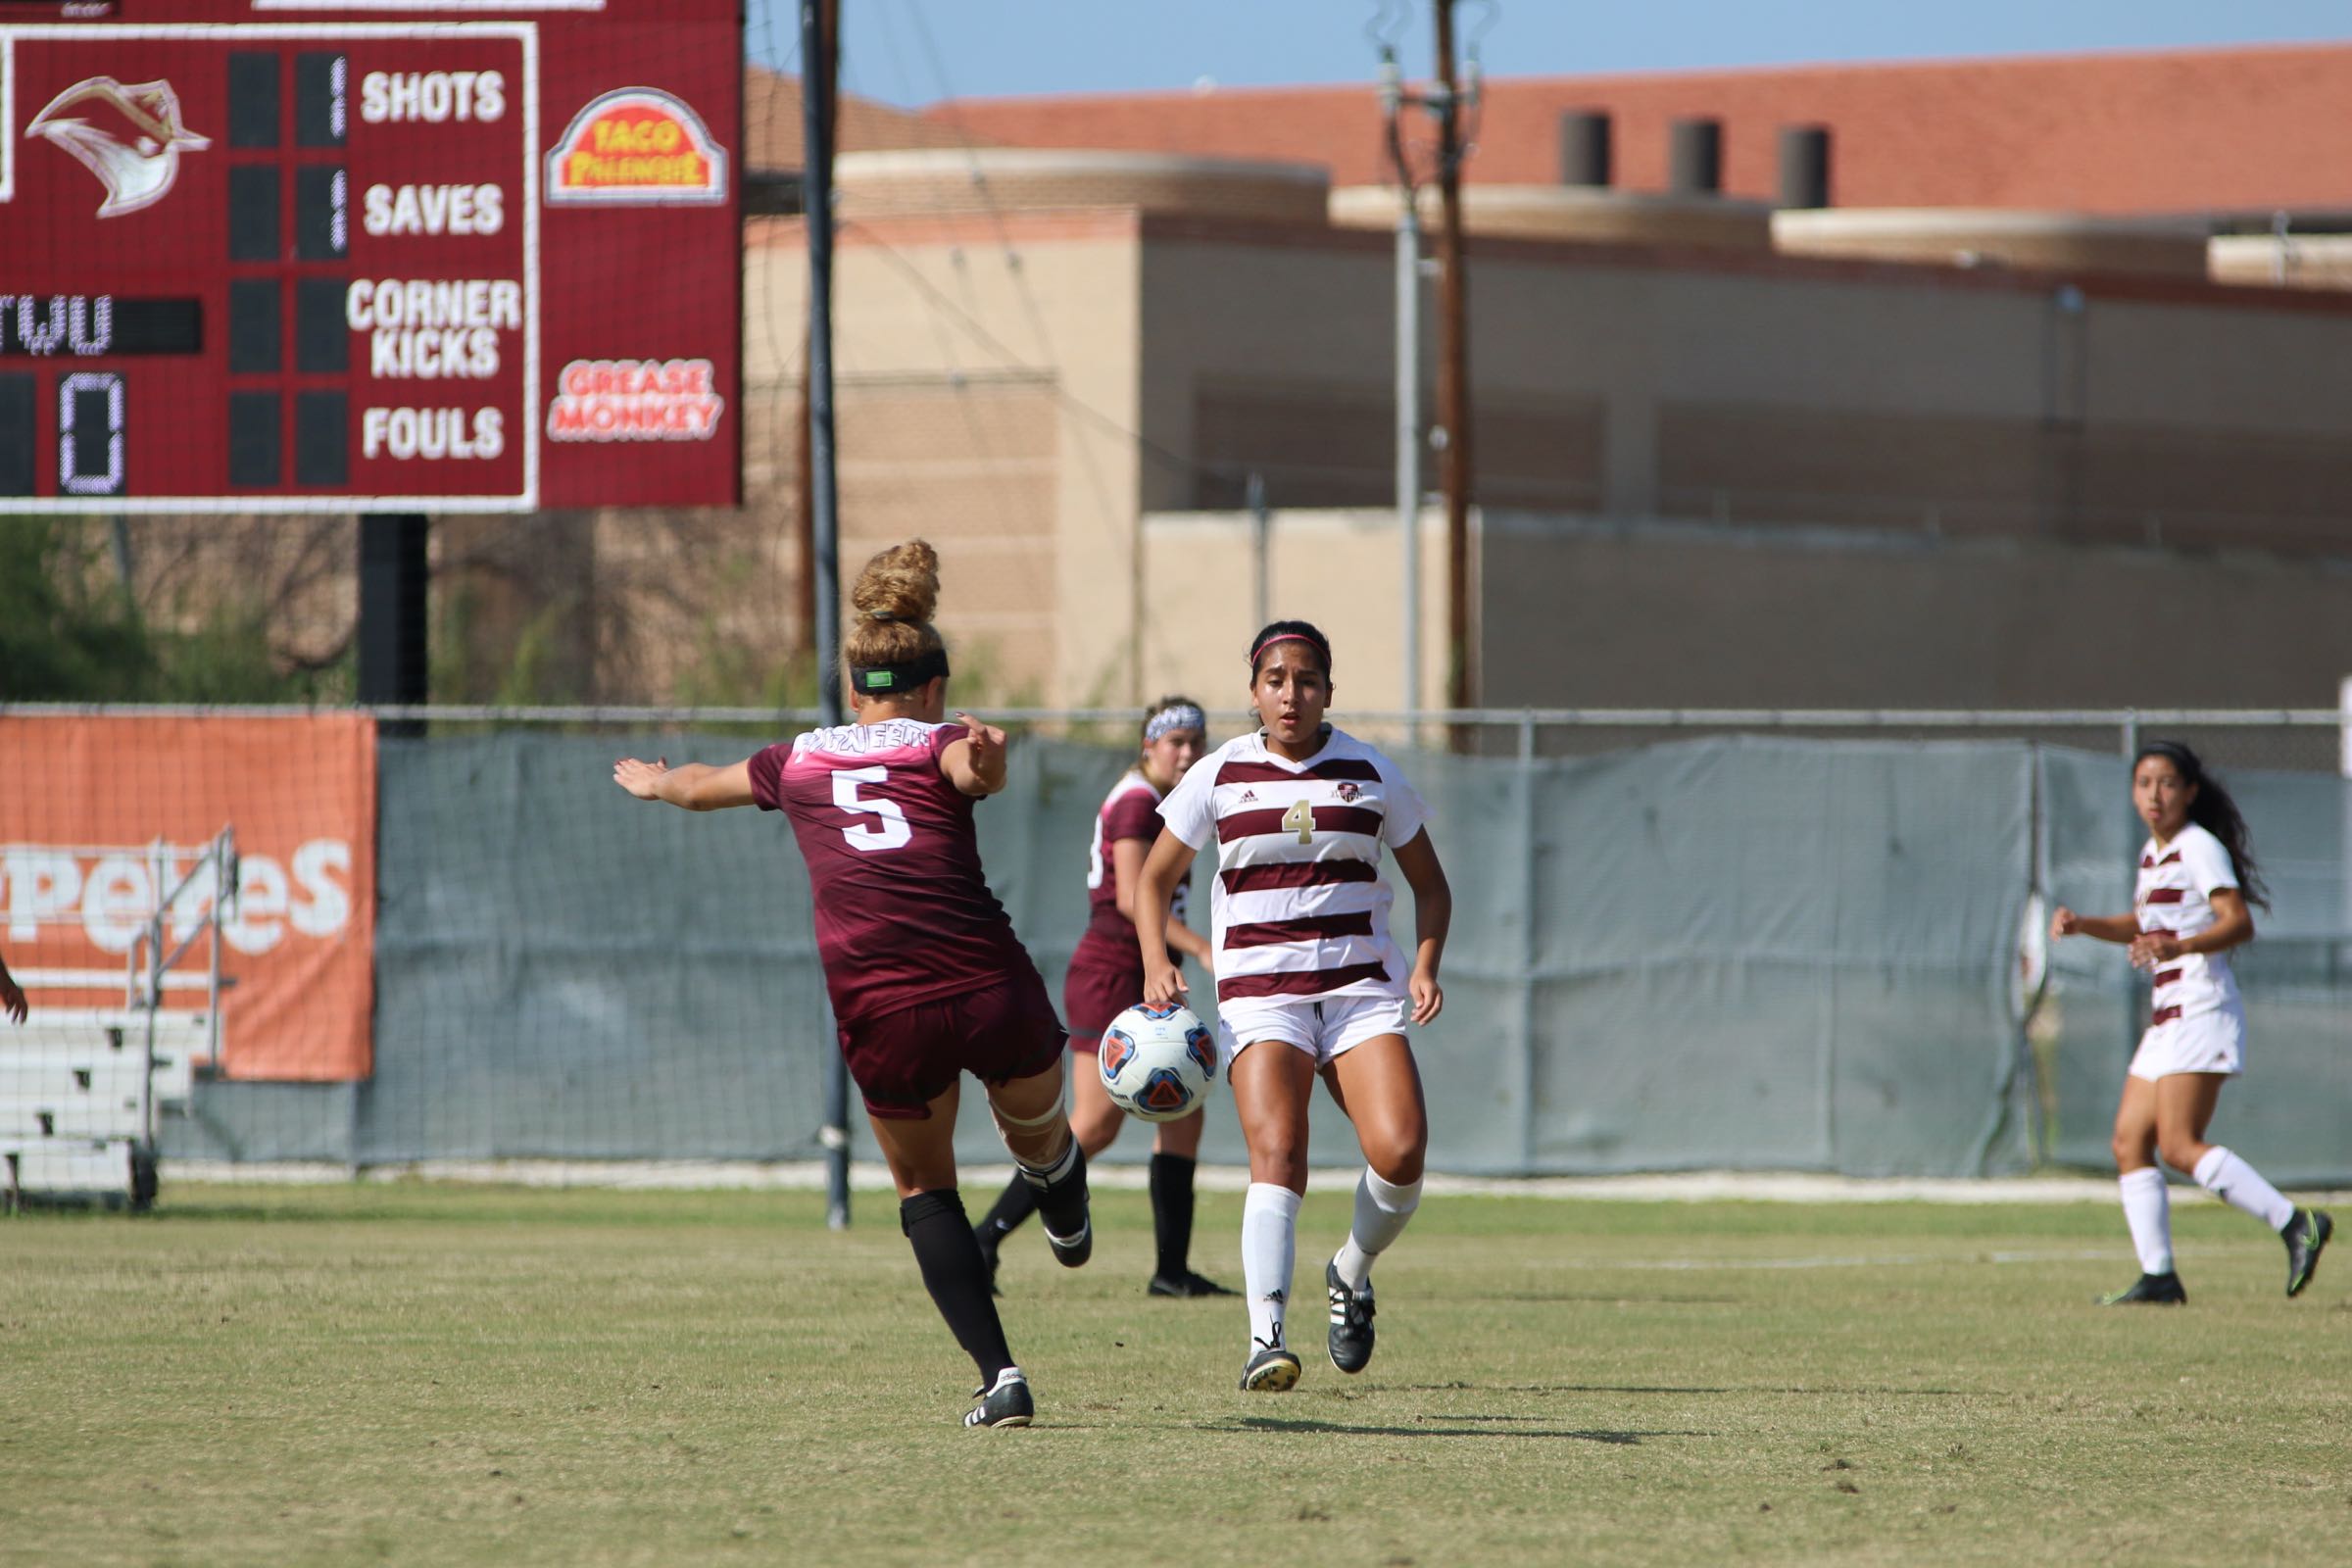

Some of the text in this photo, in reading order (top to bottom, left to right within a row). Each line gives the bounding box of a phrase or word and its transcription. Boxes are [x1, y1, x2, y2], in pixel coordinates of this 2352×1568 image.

[360, 71, 506, 123] SHOTS
[594, 119, 681, 151] TACO
[364, 183, 505, 235] SAVES
[346, 278, 522, 330] CORNER
[370, 328, 500, 379] KICKS
[566, 366, 706, 395] GREASE
[60, 372, 124, 493] 0
[363, 407, 505, 460] FOULS
[555, 403, 716, 430] MONKEY
[830, 764, 912, 852] 5
[1282, 799, 1316, 845] 4
